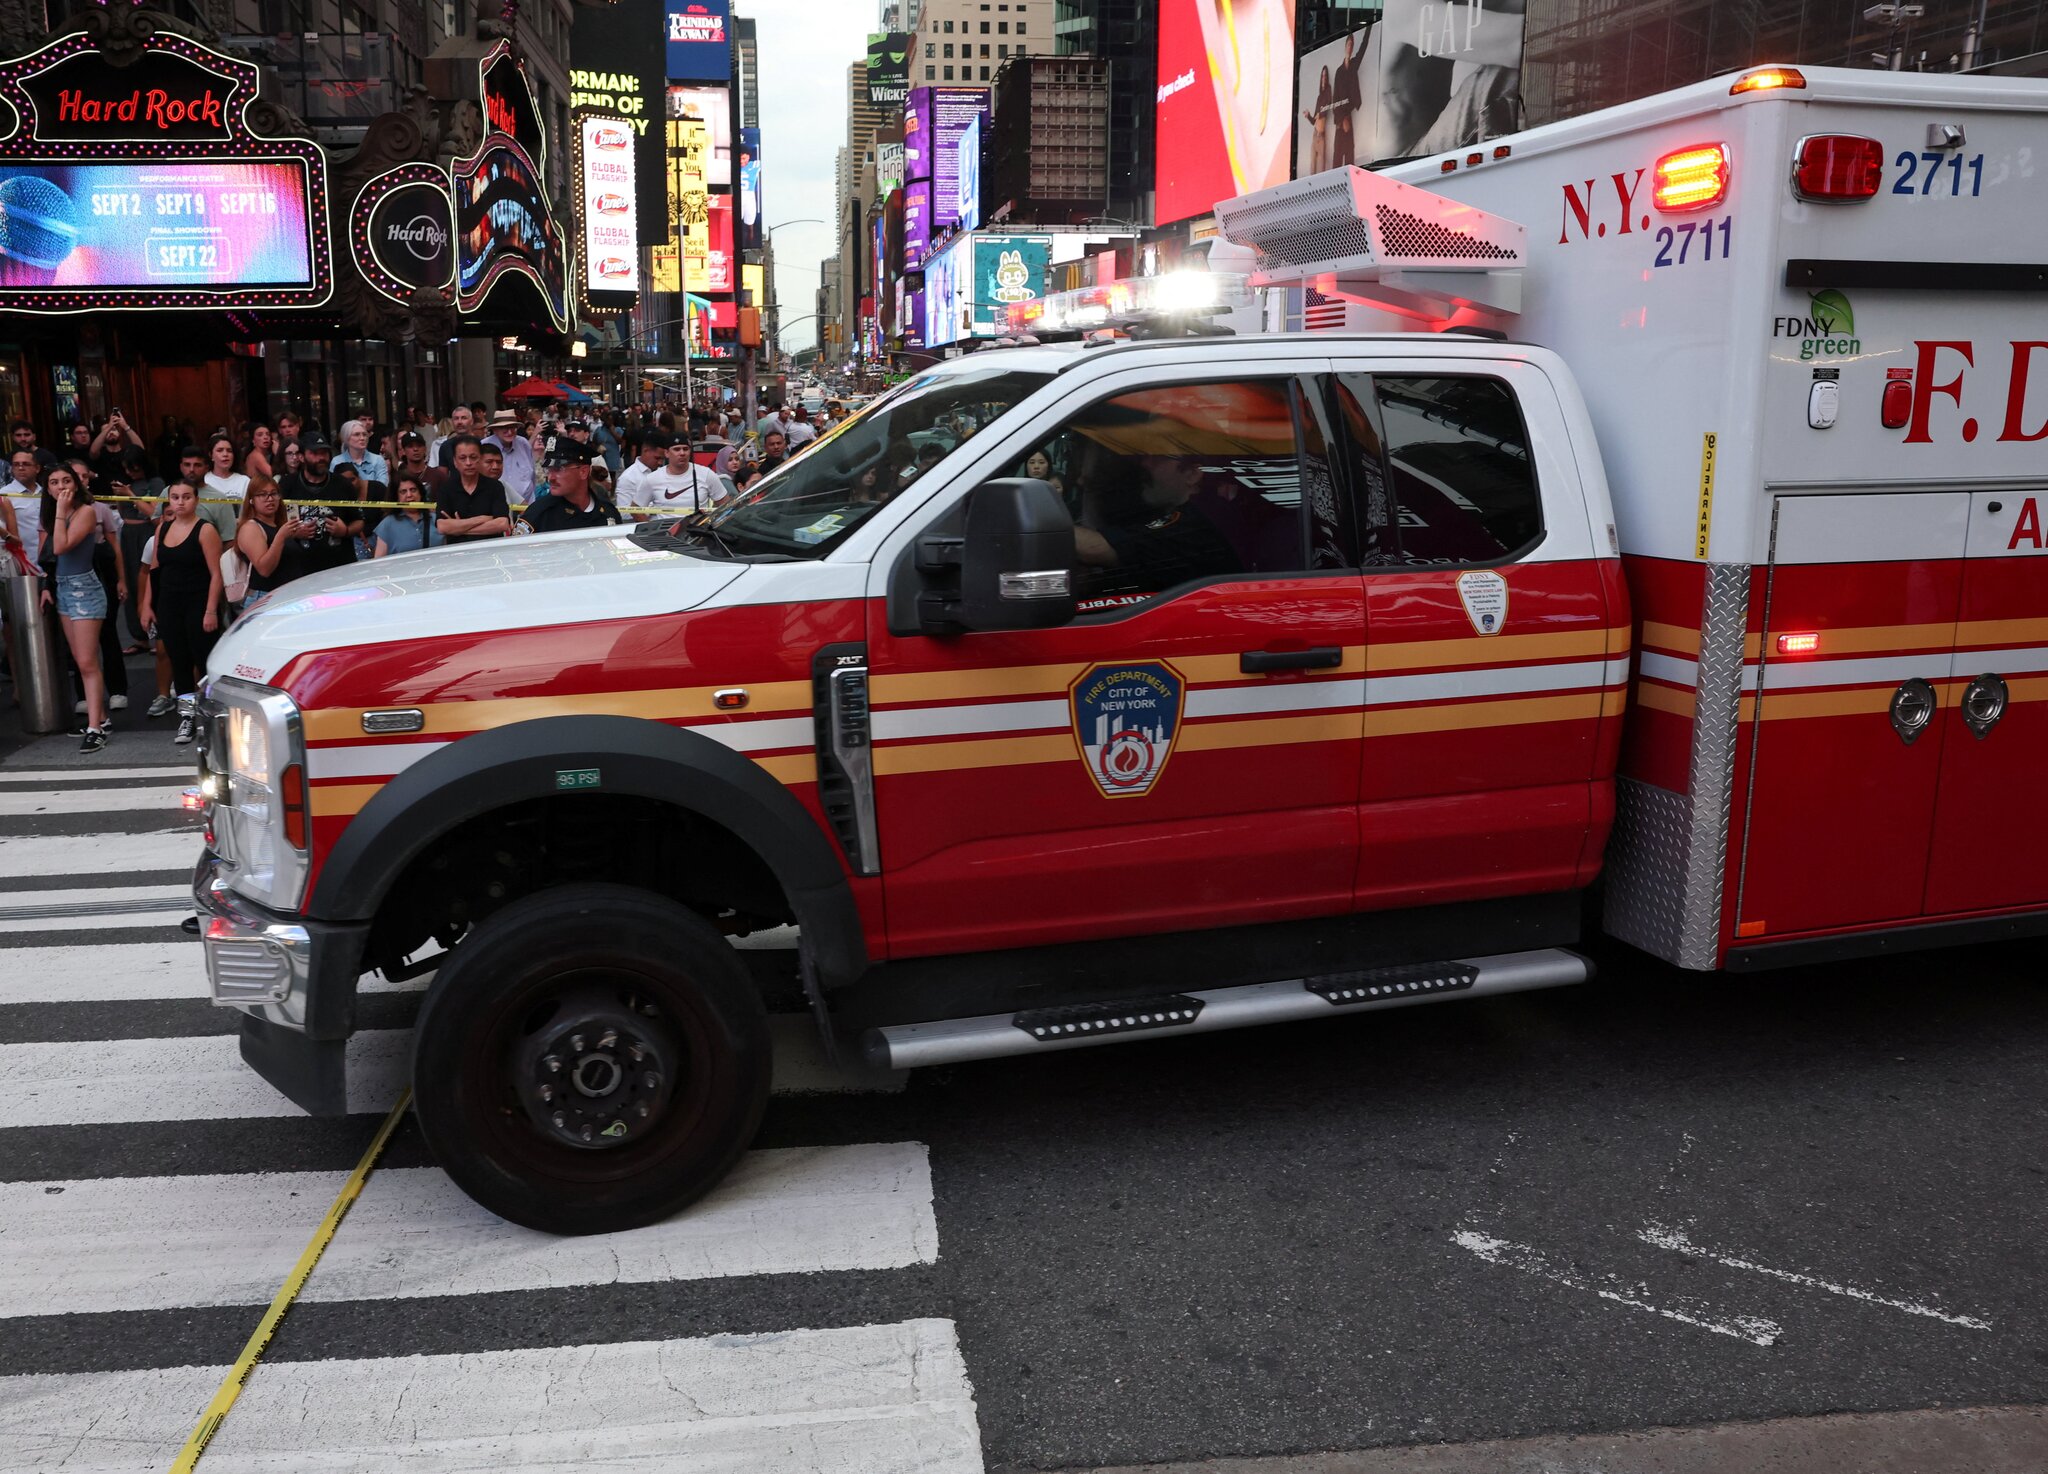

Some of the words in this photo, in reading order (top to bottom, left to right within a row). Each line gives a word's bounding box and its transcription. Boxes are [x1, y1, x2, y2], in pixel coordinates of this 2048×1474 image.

[669, 13, 722, 28] TRINIDAD
[1418, 0, 1484, 58] GAP
[669, 26, 709, 40] KEWAN
[1174, 68, 1195, 92] check
[59, 90, 139, 121] Hard
[146, 90, 221, 128] Rock
[618, 96, 643, 114] OF
[592, 162, 627, 174] GLOBAL
[592, 173, 628, 183] FLAGSHIP
[1892, 151, 1984, 196] 2711
[92, 193, 129, 216] SEPT
[131, 193, 141, 215] 2
[155, 193, 192, 215] SEPT
[195, 193, 205, 215] 9
[219, 192, 257, 214] SEPT
[259, 192, 276, 214] 16
[1559, 168, 1650, 244] N.Y.
[388, 225, 425, 242] Hard
[426, 227, 448, 247] Rock
[594, 227, 629, 238] GLOBAL
[594, 237, 630, 247] FLAGSHIP
[1654, 216, 1731, 267] 2711
[160, 246, 197, 267] SEPT
[199, 246, 217, 267] 22
[1773, 317, 1835, 337] FDNY
[1800, 339, 1861, 360] green
[836, 656, 863, 665] XLT
[1085, 680, 1107, 704] FIRE
[1106, 671, 1172, 698] DEPARTMENT
[1108, 688, 1133, 698] CITY
[1134, 687, 1149, 697] OF
[1100, 701, 1125, 711] NEW
[1127, 699, 1156, 709] YORK
